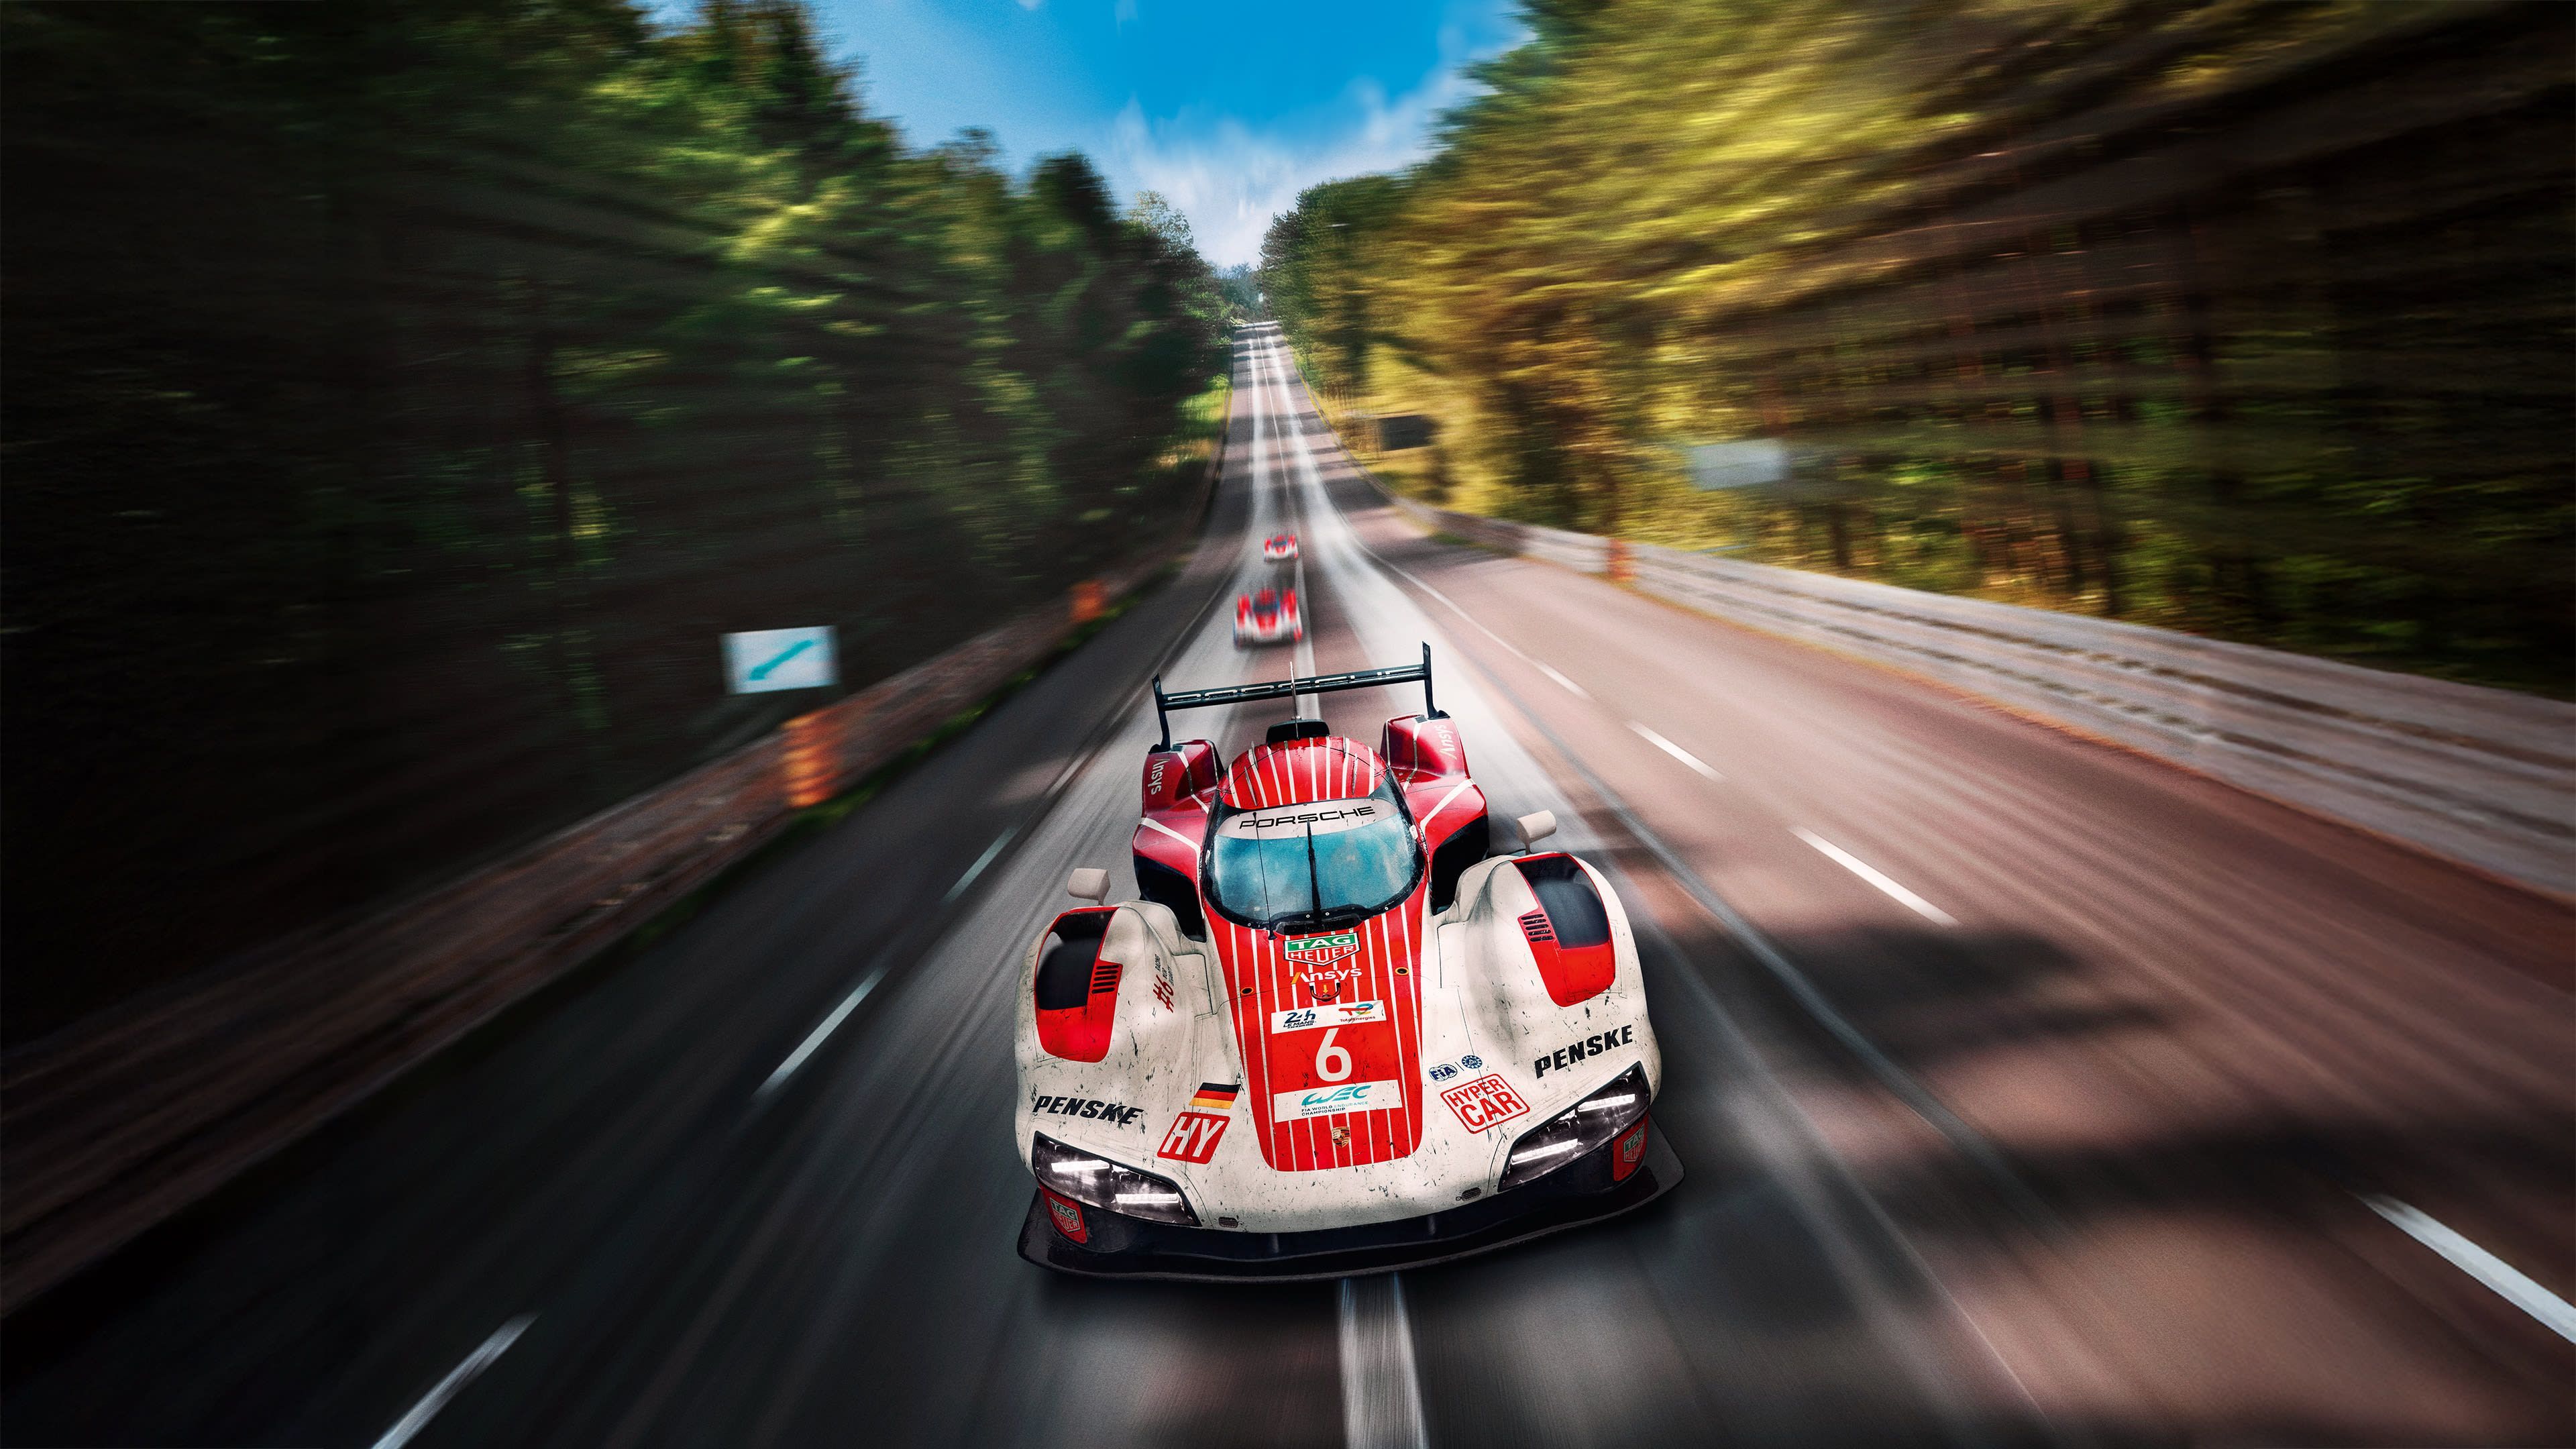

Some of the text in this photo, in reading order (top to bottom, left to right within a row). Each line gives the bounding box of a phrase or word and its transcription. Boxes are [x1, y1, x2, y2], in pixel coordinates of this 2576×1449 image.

[1434, 724, 1458, 760] Ansys
[1148, 758, 1171, 795] Ansys
[1239, 806, 1376, 829] PORSCHE
[1290, 945, 1354, 963] HEUER
[1291, 936, 1351, 949] TAG
[1291, 968, 1362, 985] Ansys
[1152, 974, 1174, 1013] #6
[1316, 1028, 1352, 1082] 6
[1534, 1024, 1633, 1079] PENSKE
[1301, 1085, 1372, 1106] WEC
[1446, 1079, 1505, 1107] HYPER
[1032, 1095, 1144, 1124] PENSKE
[1301, 1107, 1346, 1116] CHAMPIONSHIP
[1460, 1091, 1523, 1127] CAR
[1161, 1116, 1226, 1157] HY
[1625, 1129, 1644, 1149] TAG
[1051, 1201, 1076, 1220] TAG
